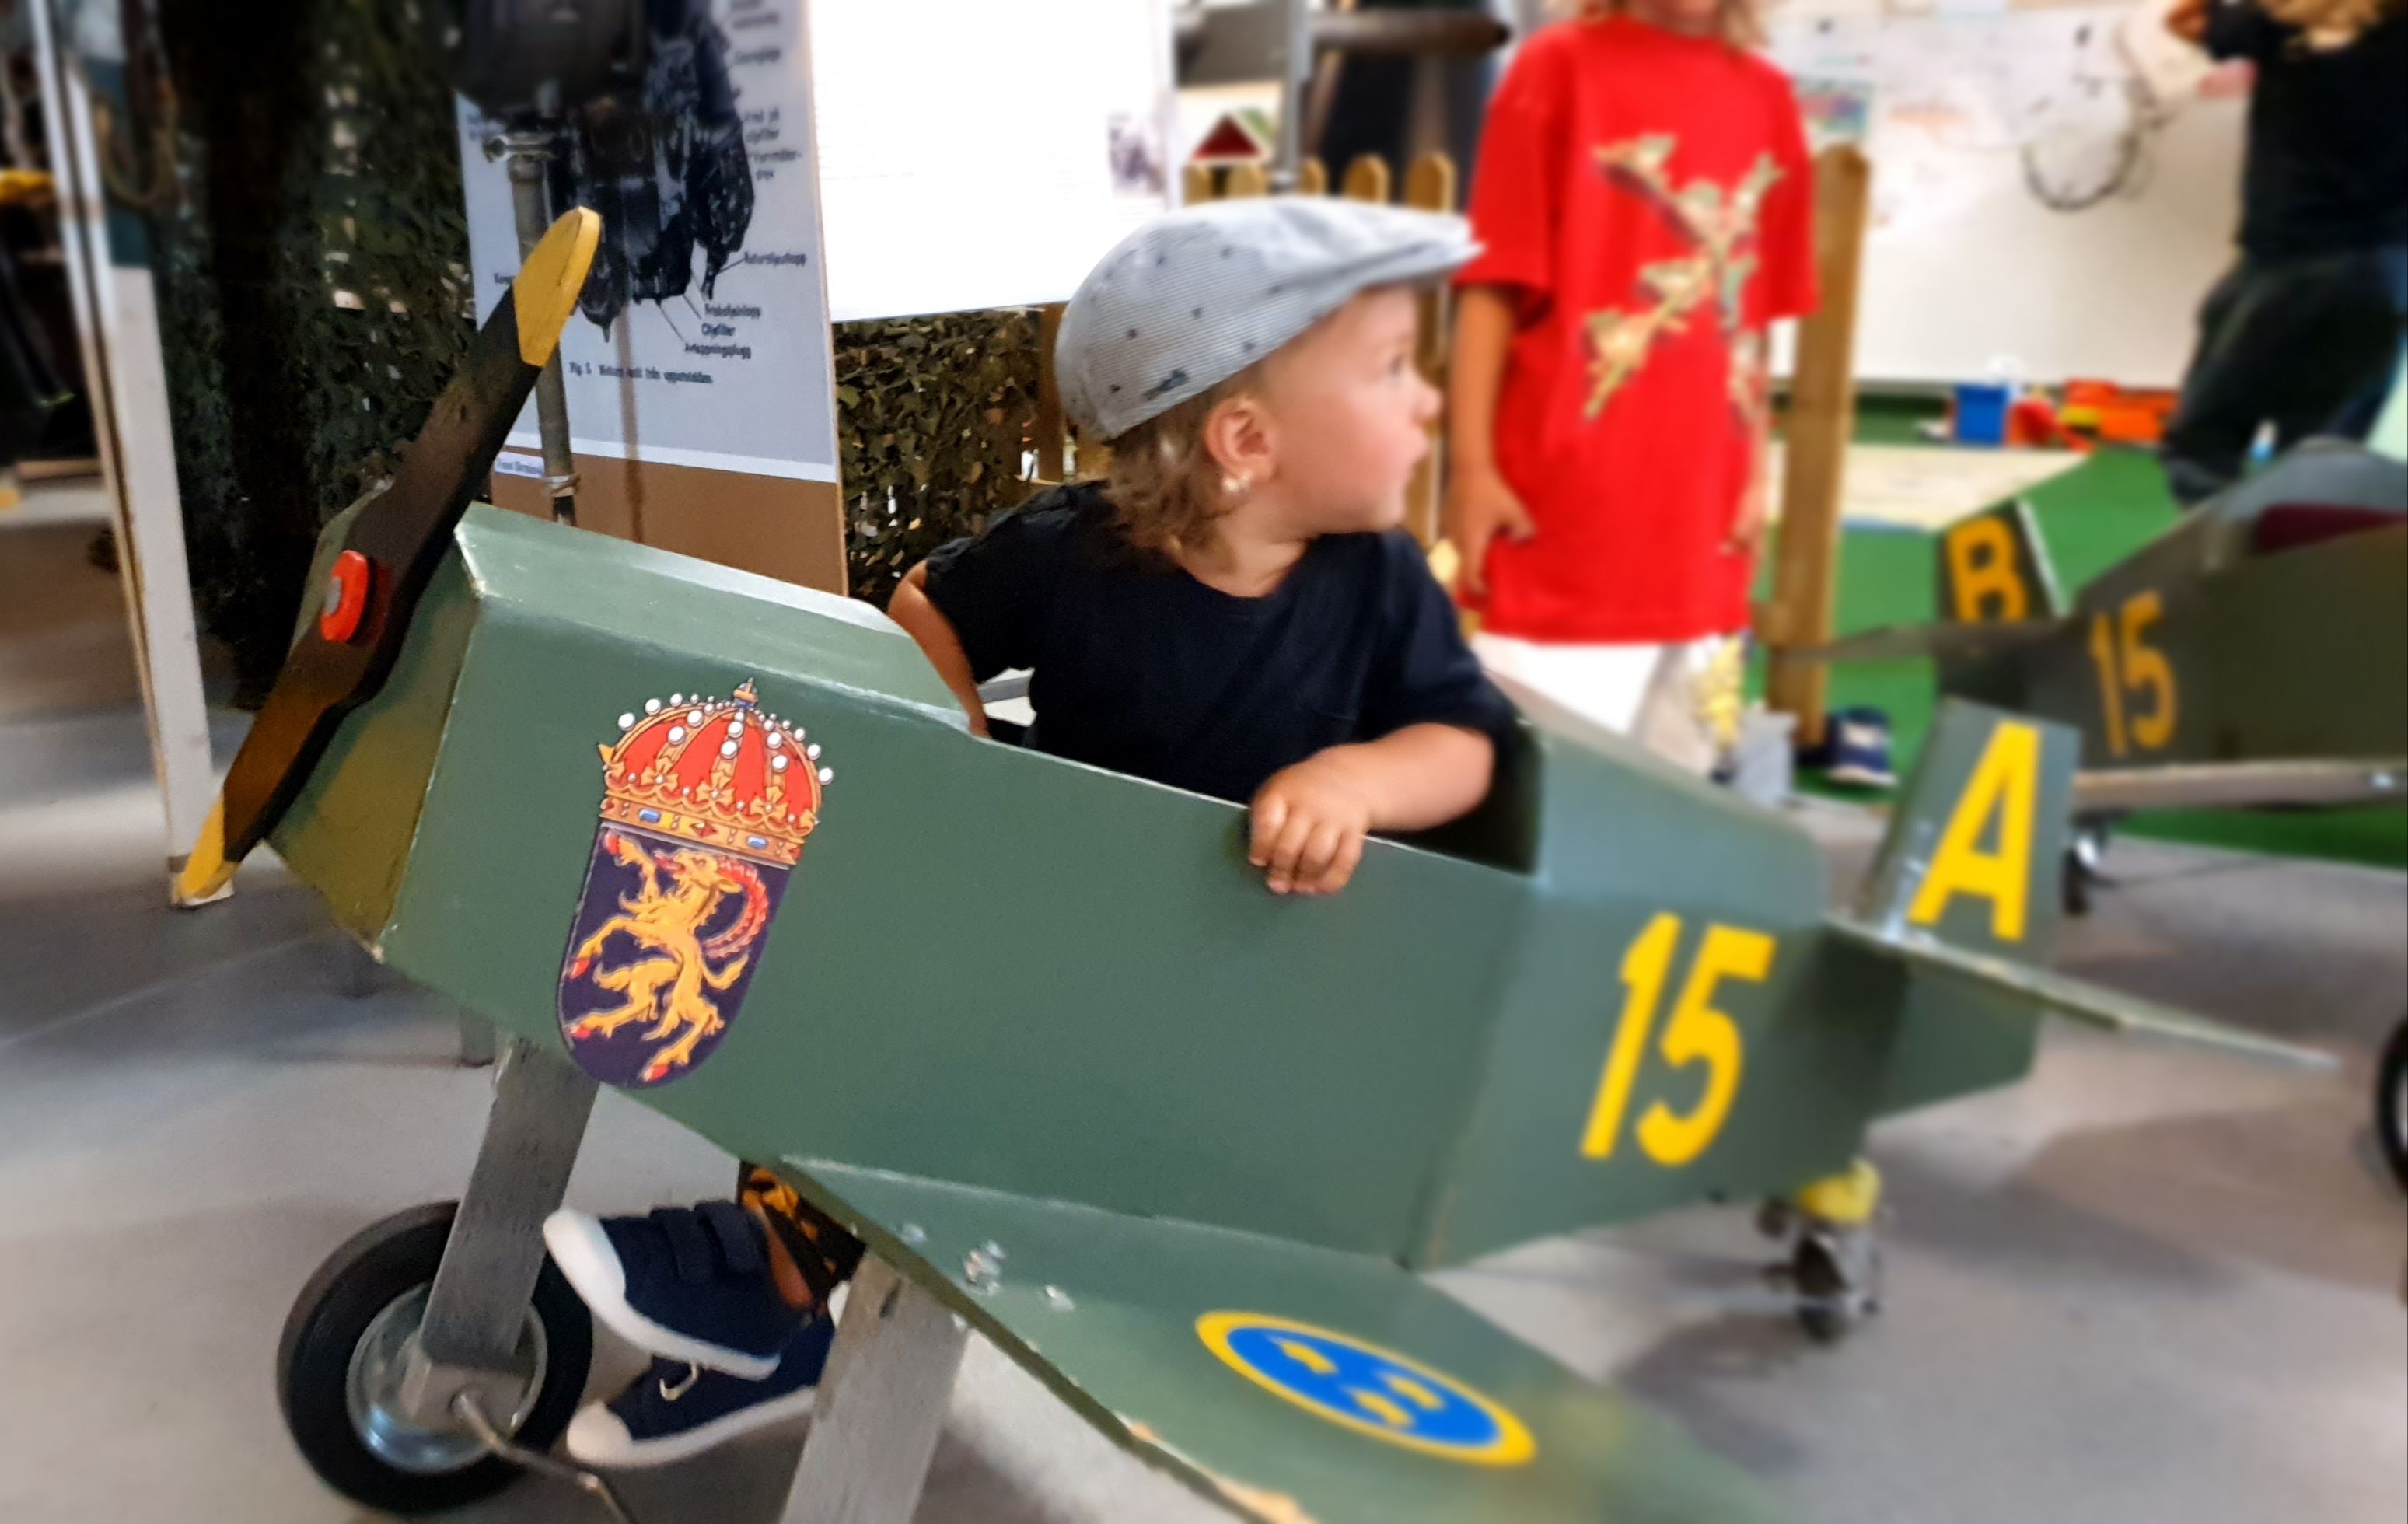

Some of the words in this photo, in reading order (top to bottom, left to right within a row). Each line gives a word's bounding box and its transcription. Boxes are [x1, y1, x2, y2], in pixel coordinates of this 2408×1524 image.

[2088, 589, 2178, 760] 15
[1906, 718, 2042, 943] A
[1580, 911, 1777, 1167] 15
